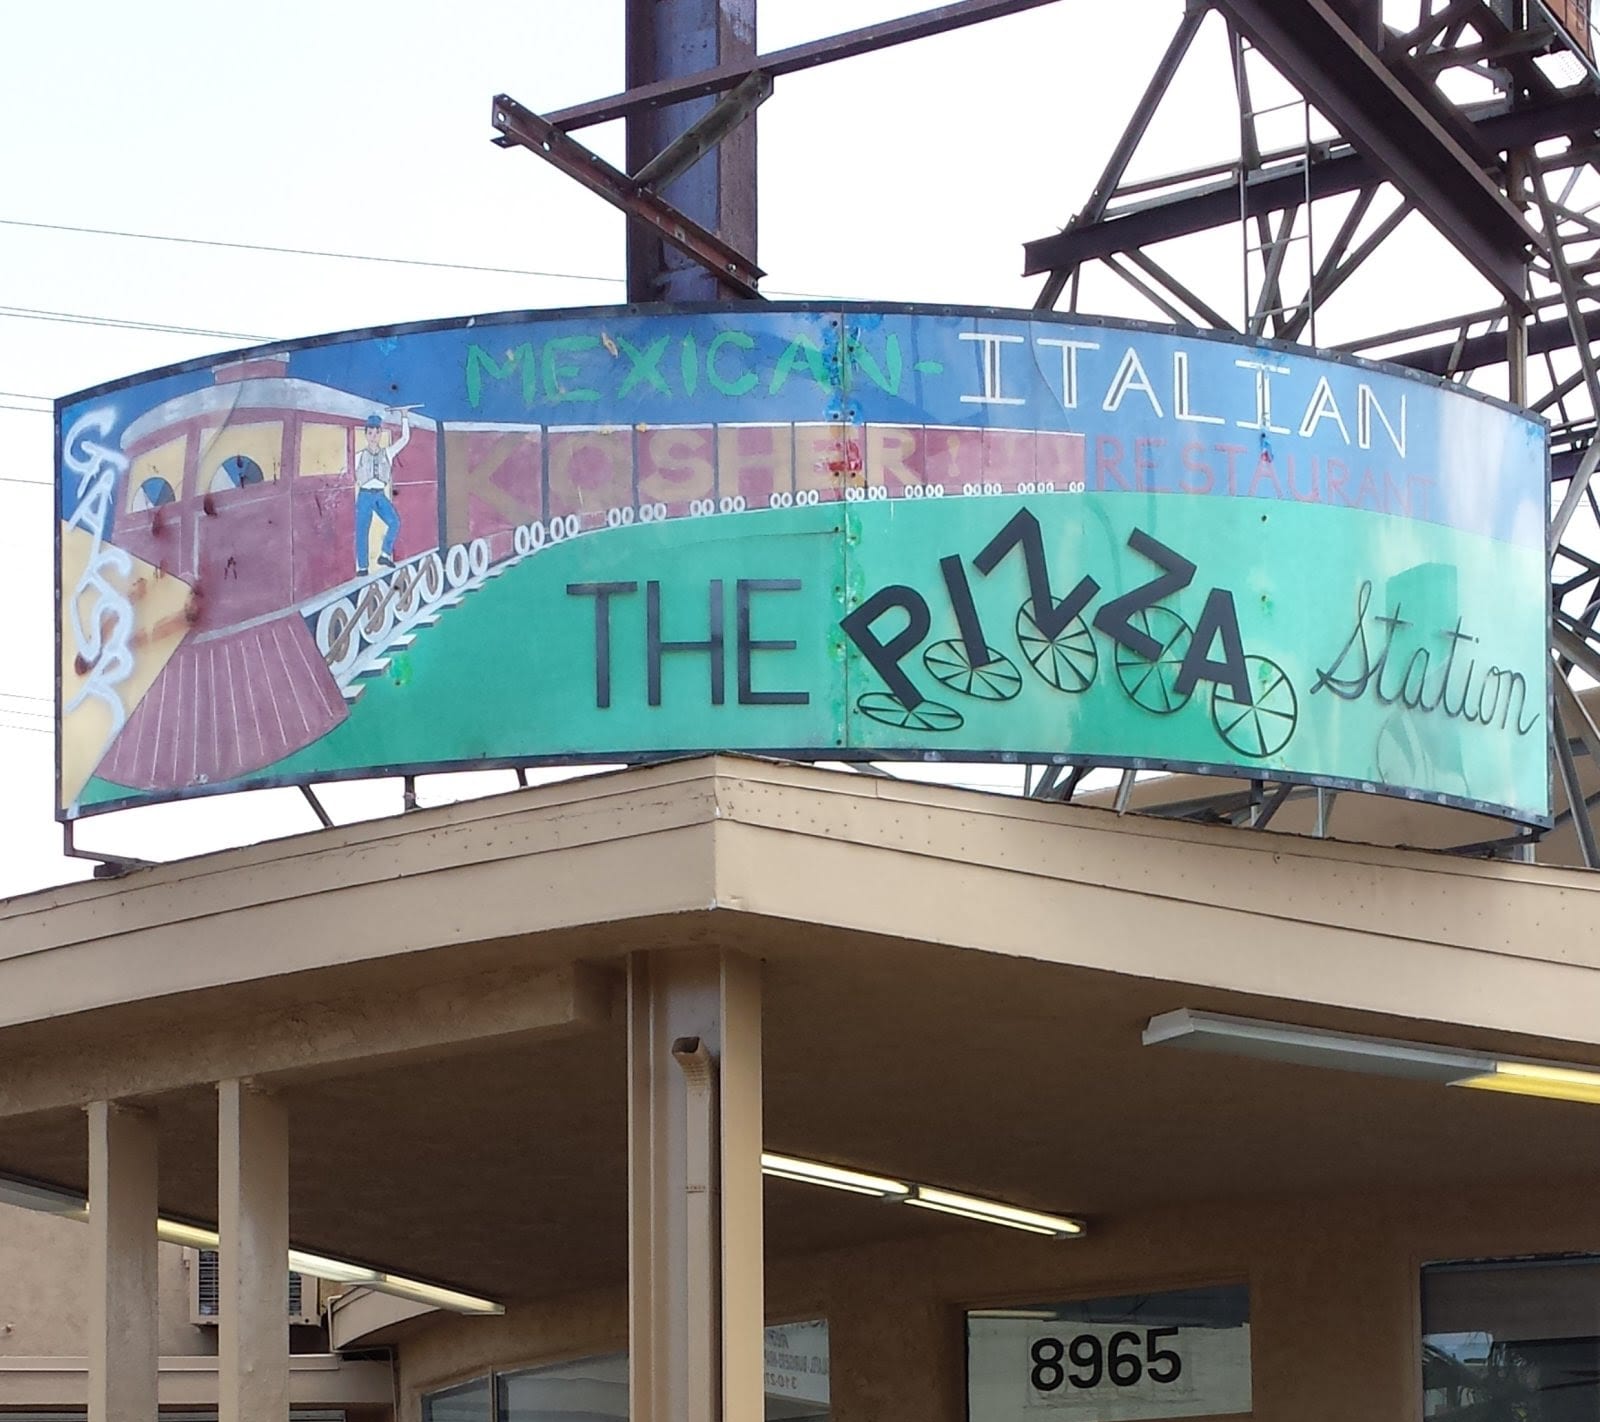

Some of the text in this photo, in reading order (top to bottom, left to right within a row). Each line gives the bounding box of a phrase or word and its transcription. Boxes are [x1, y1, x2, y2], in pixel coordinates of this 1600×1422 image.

[959, 332, 1408, 459] ITALIAN
[1096, 434, 1437, 520] RESTAURANT
[566, 506, 1541, 736] THE PIZZA Station
[1031, 1326, 1182, 1391] 8965
